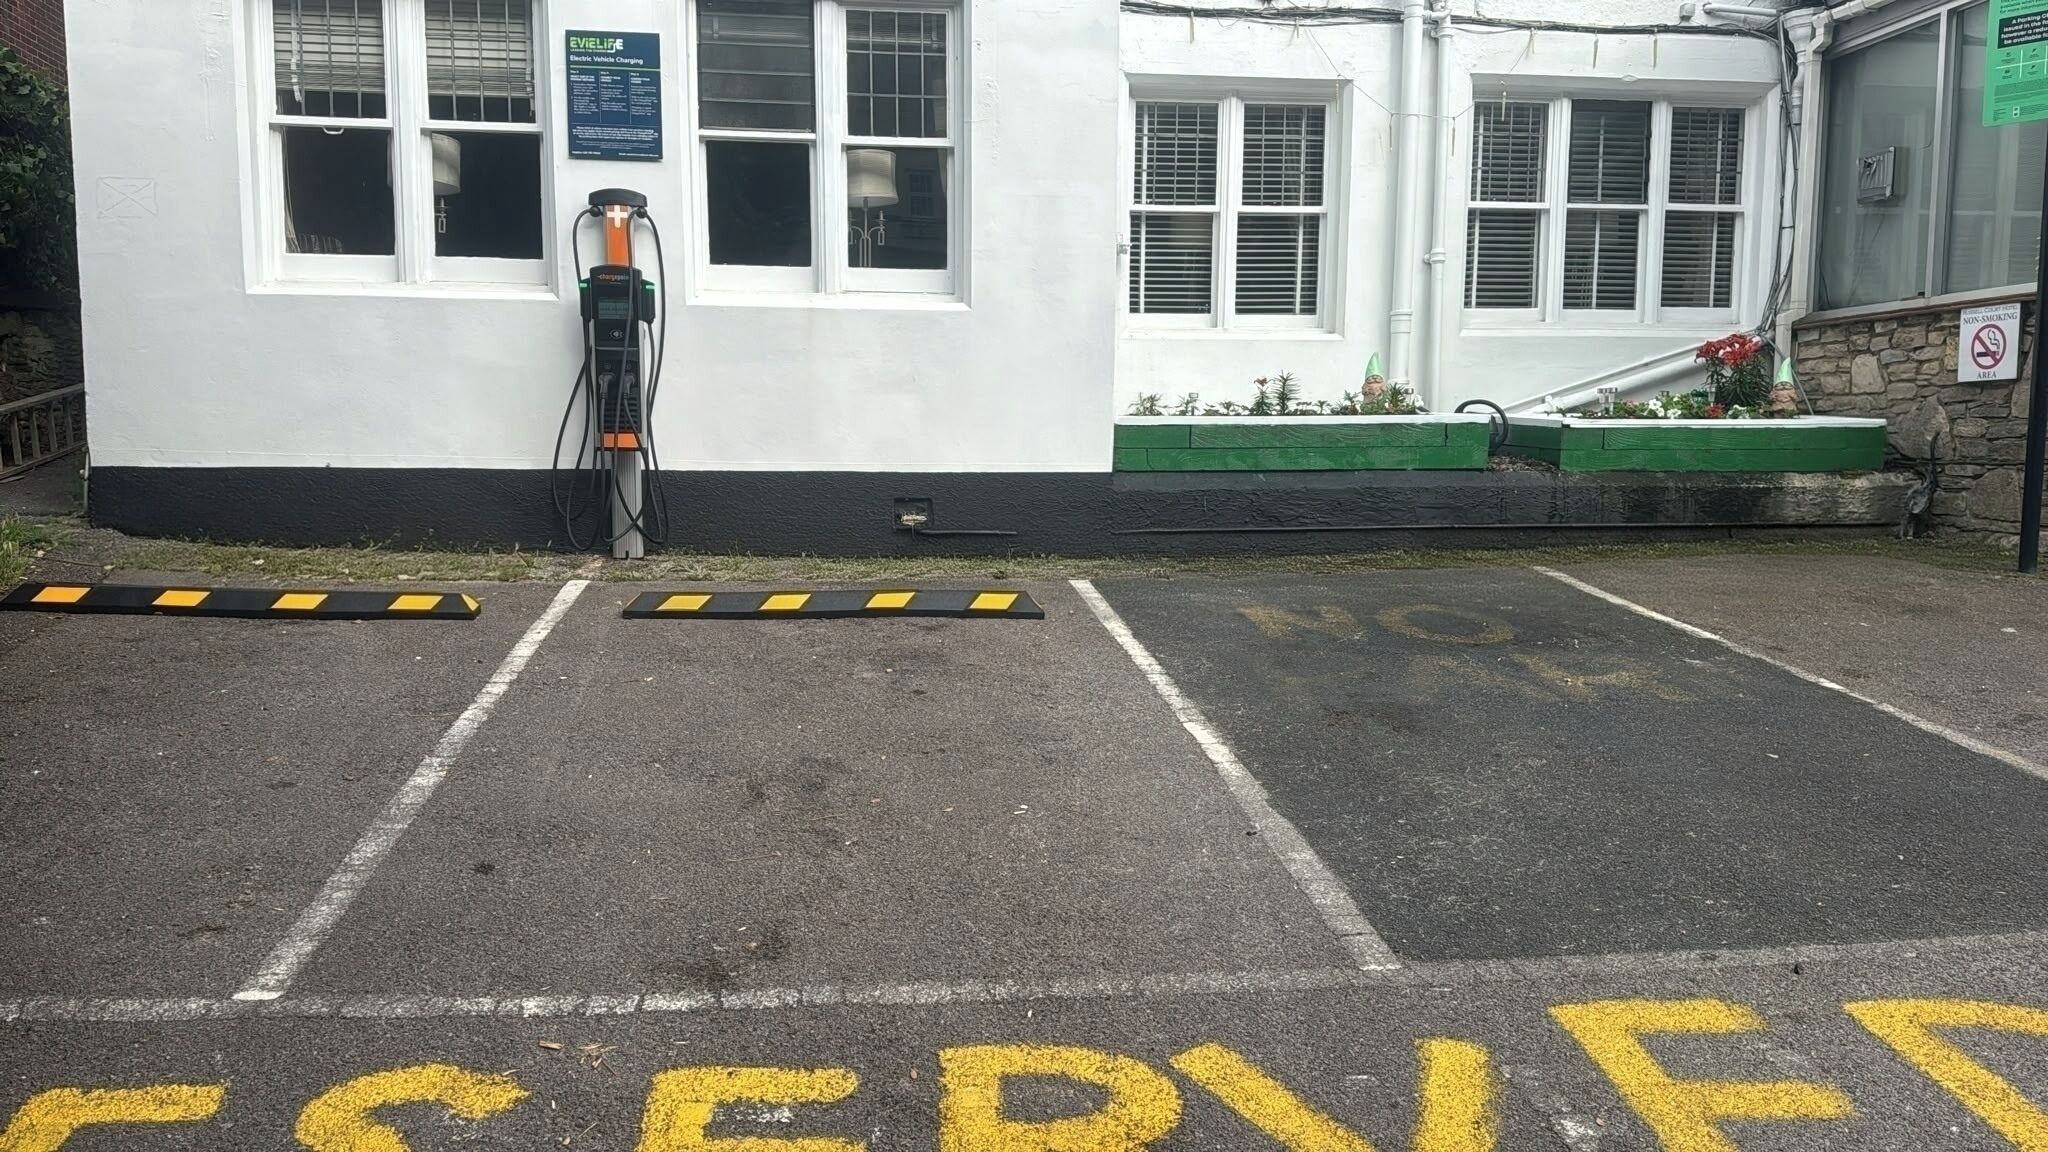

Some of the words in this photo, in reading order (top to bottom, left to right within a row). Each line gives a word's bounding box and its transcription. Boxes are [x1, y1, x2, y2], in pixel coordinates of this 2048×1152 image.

[616, 56, 644, 65] Charging
[1963, 312, 2018, 325] NON-SMOKING
[1976, 371, 1997, 379] AREA
